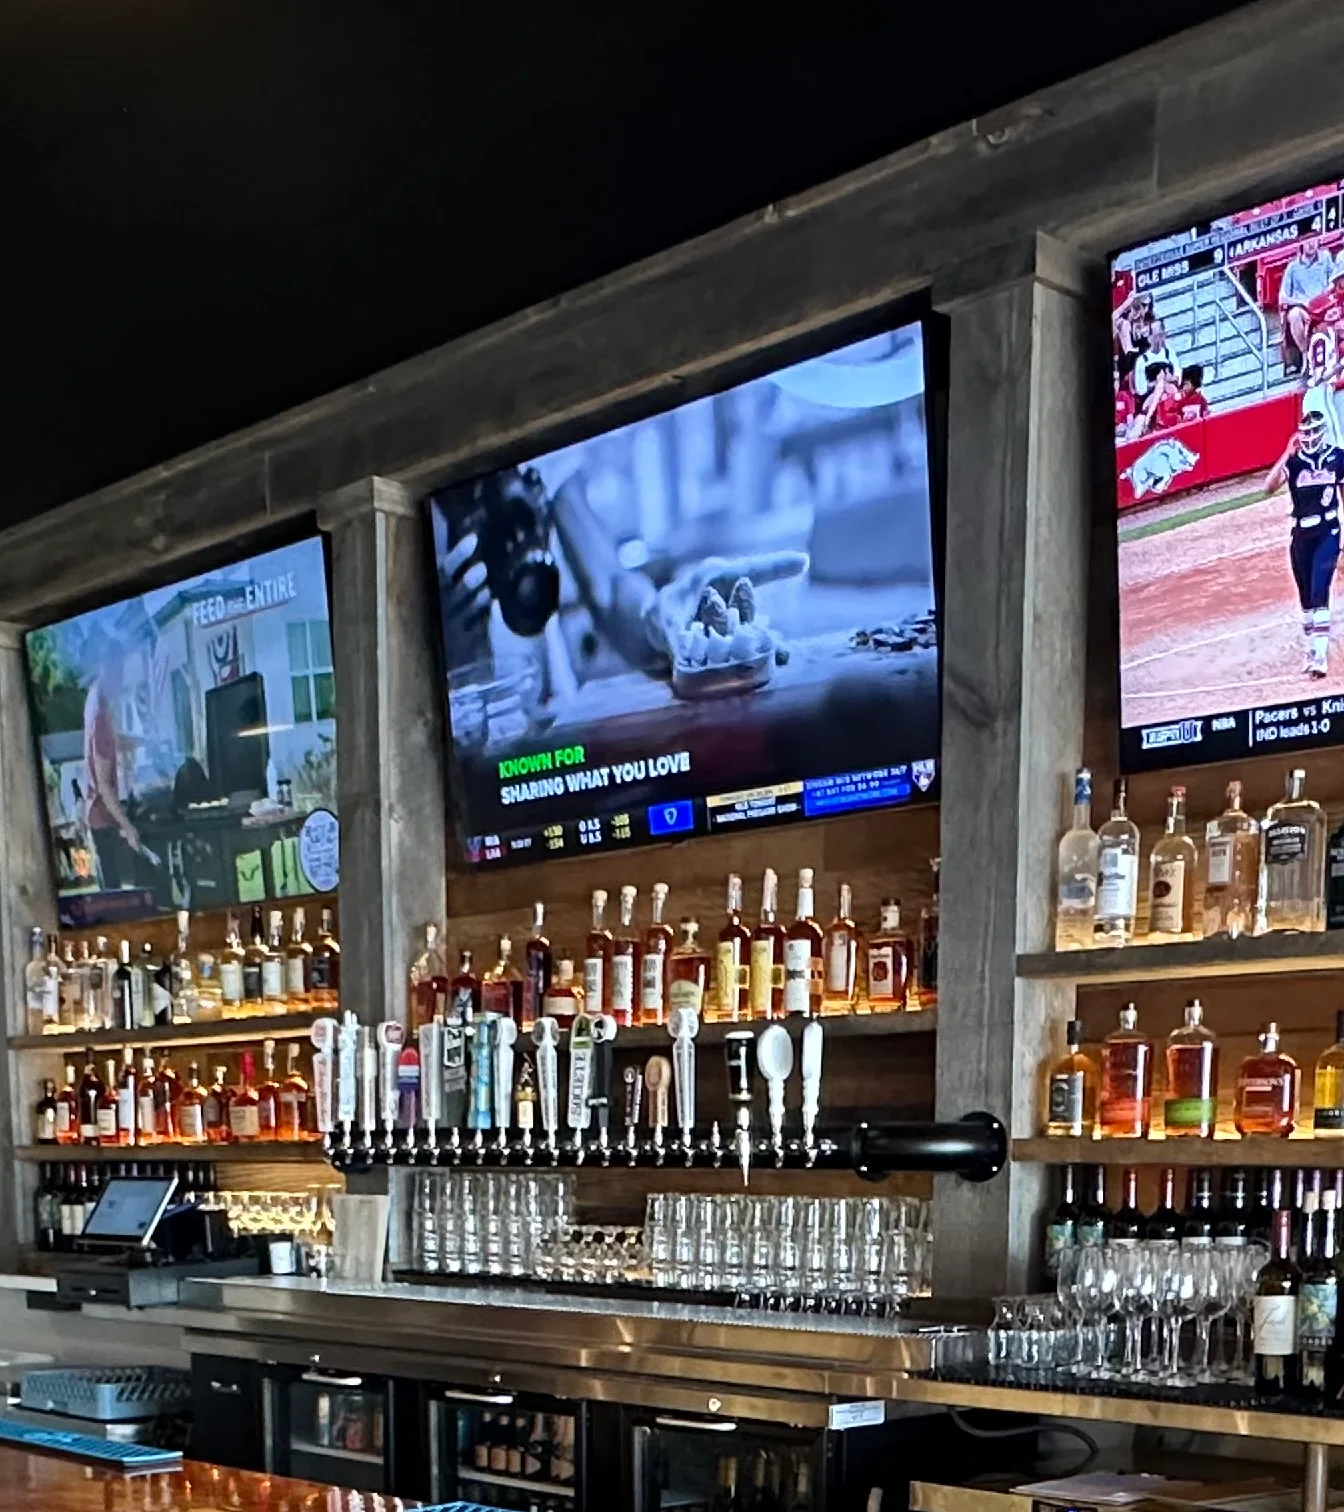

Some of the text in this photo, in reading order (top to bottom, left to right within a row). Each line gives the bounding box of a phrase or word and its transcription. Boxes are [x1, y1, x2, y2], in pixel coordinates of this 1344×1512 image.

[1236, 224, 1299, 256] ARKANSAS
[1137, 270, 1160, 288] OLE
[192, 594, 226, 625] FEED
[245, 571, 297, 610] ENTIRE
[1255, 706, 1299, 725] Pacers
[1302, 704, 1317, 717] vs
[498, 745, 586, 780] KNOWN FOR
[500, 750, 692, 806] SHARING WHAT YOU LOVE
